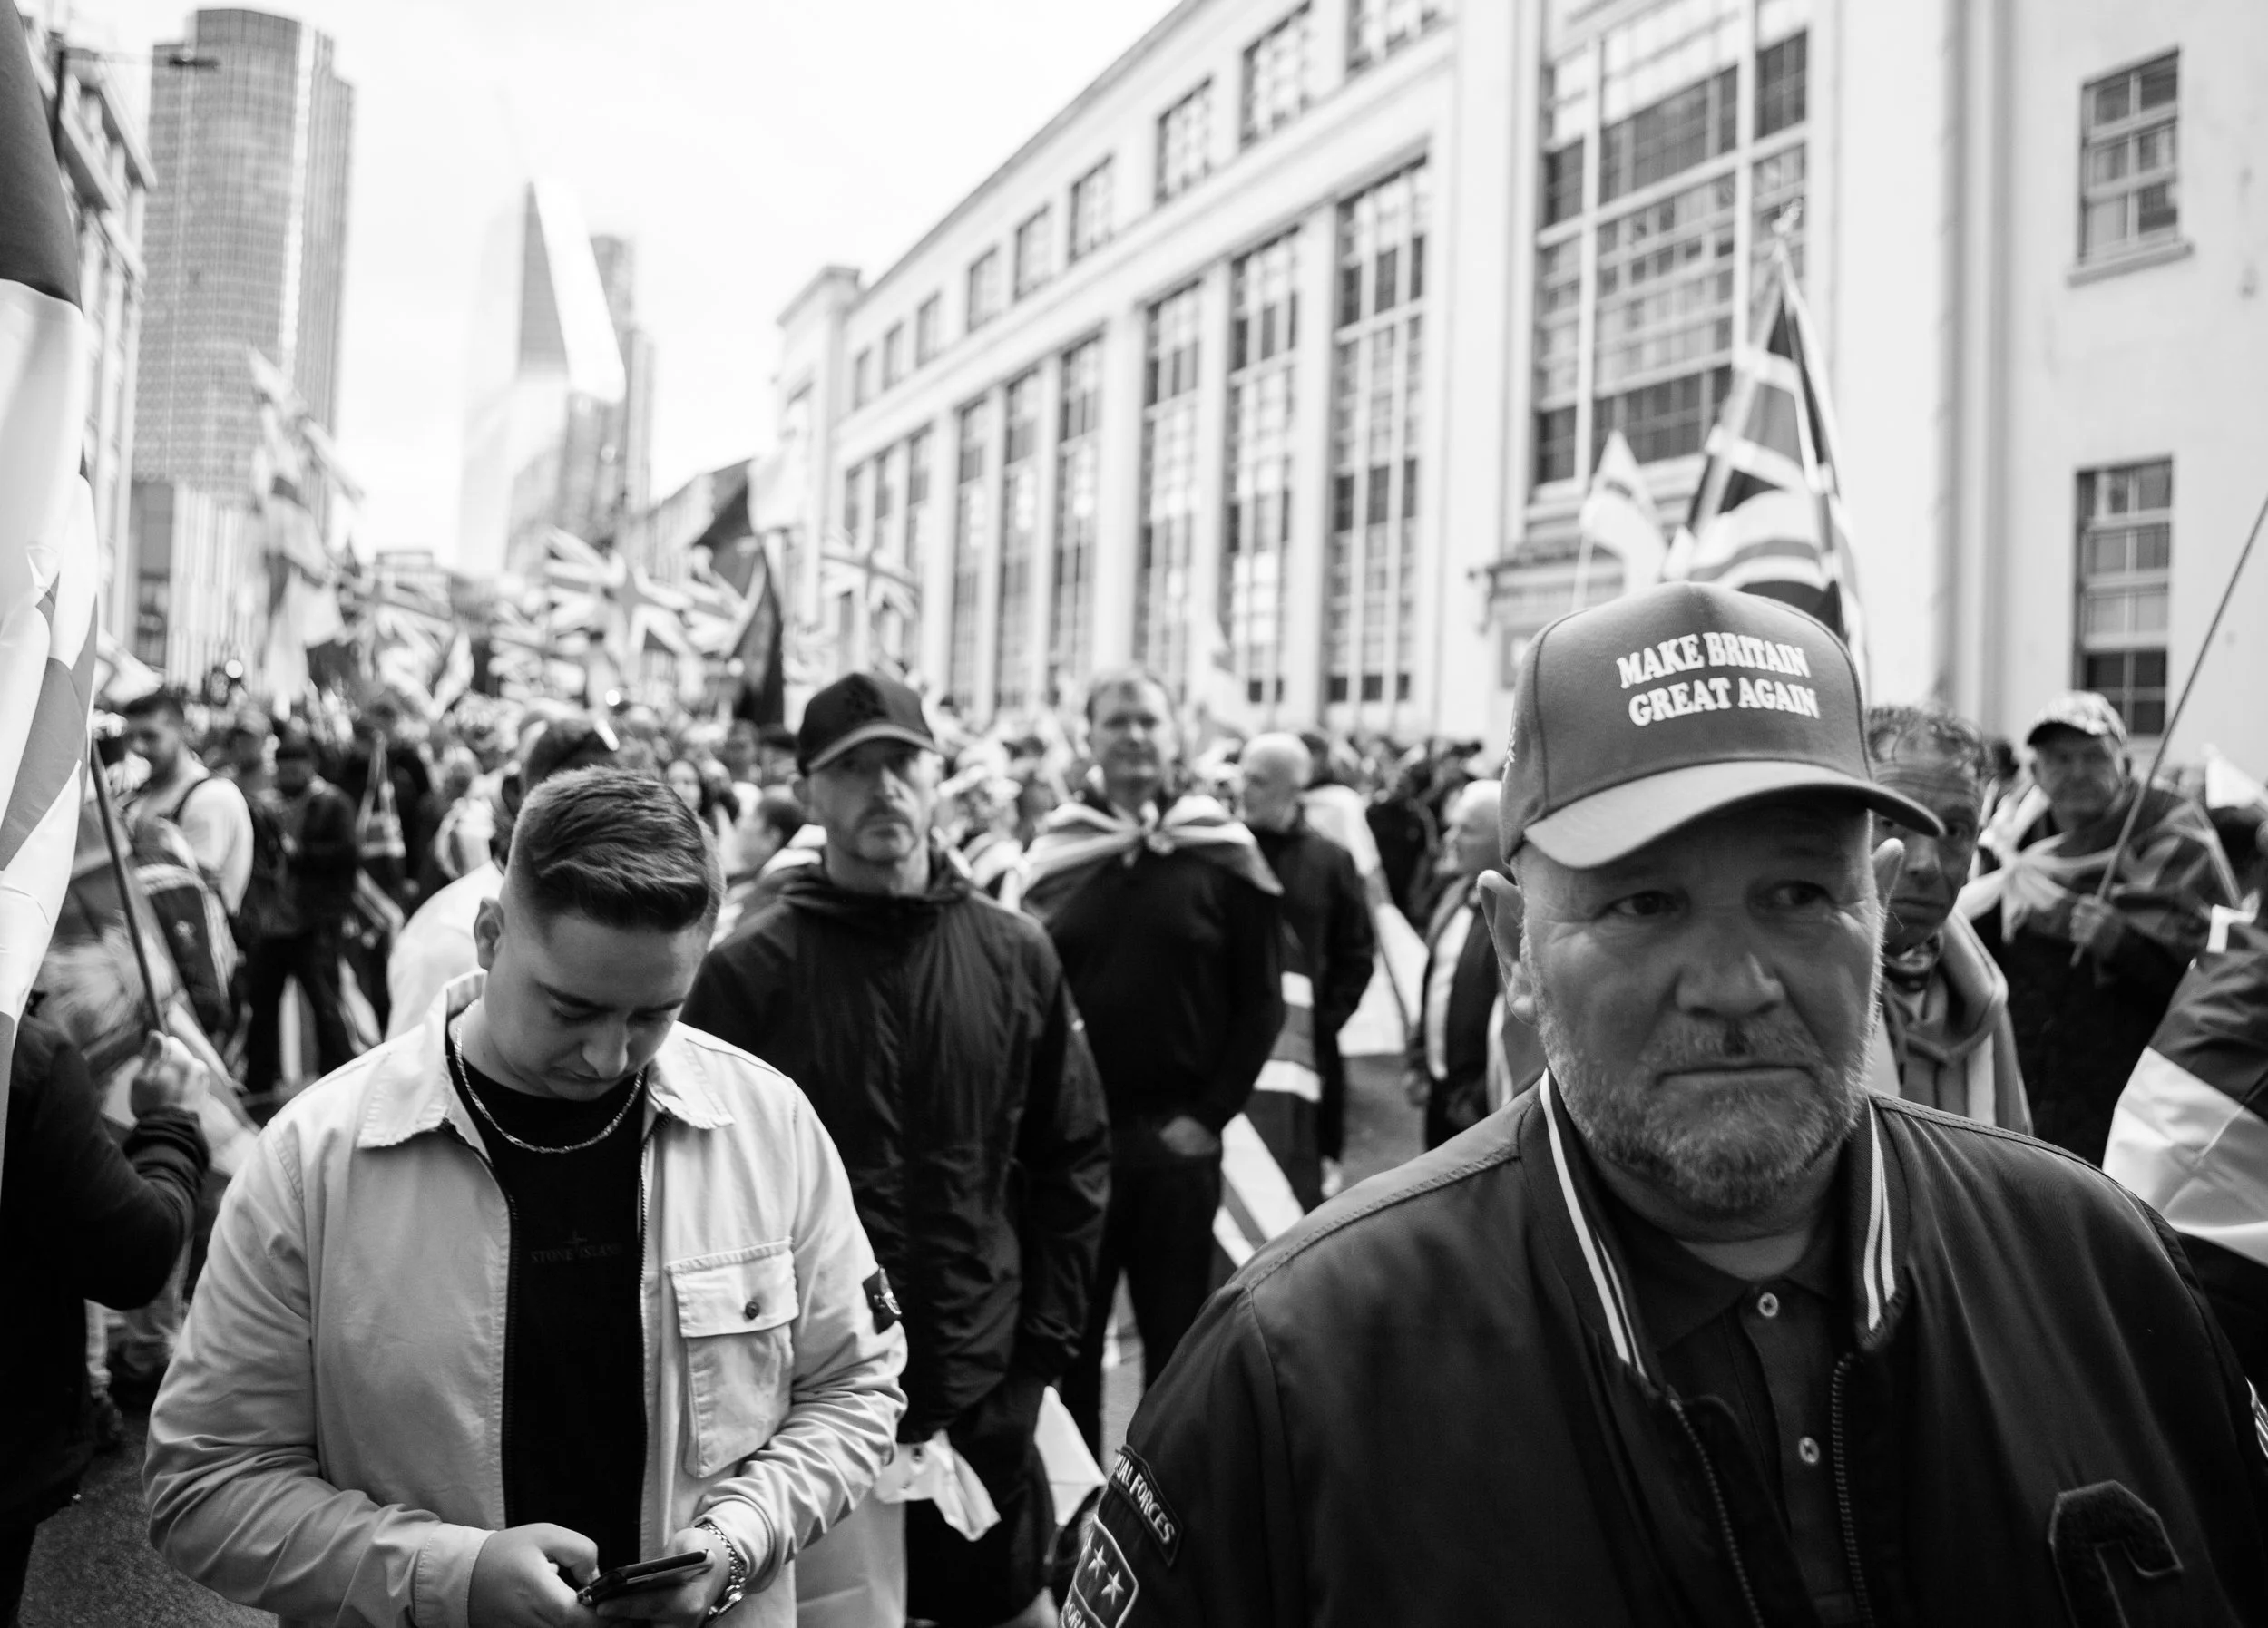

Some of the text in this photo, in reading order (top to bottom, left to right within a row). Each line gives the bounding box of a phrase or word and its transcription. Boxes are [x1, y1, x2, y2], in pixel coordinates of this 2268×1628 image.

[1616, 631, 1812, 689] MAKE BRITAIN
[1628, 677, 1821, 726] GREAT AGAIN
[1129, 1472, 1177, 1545] FORCES
